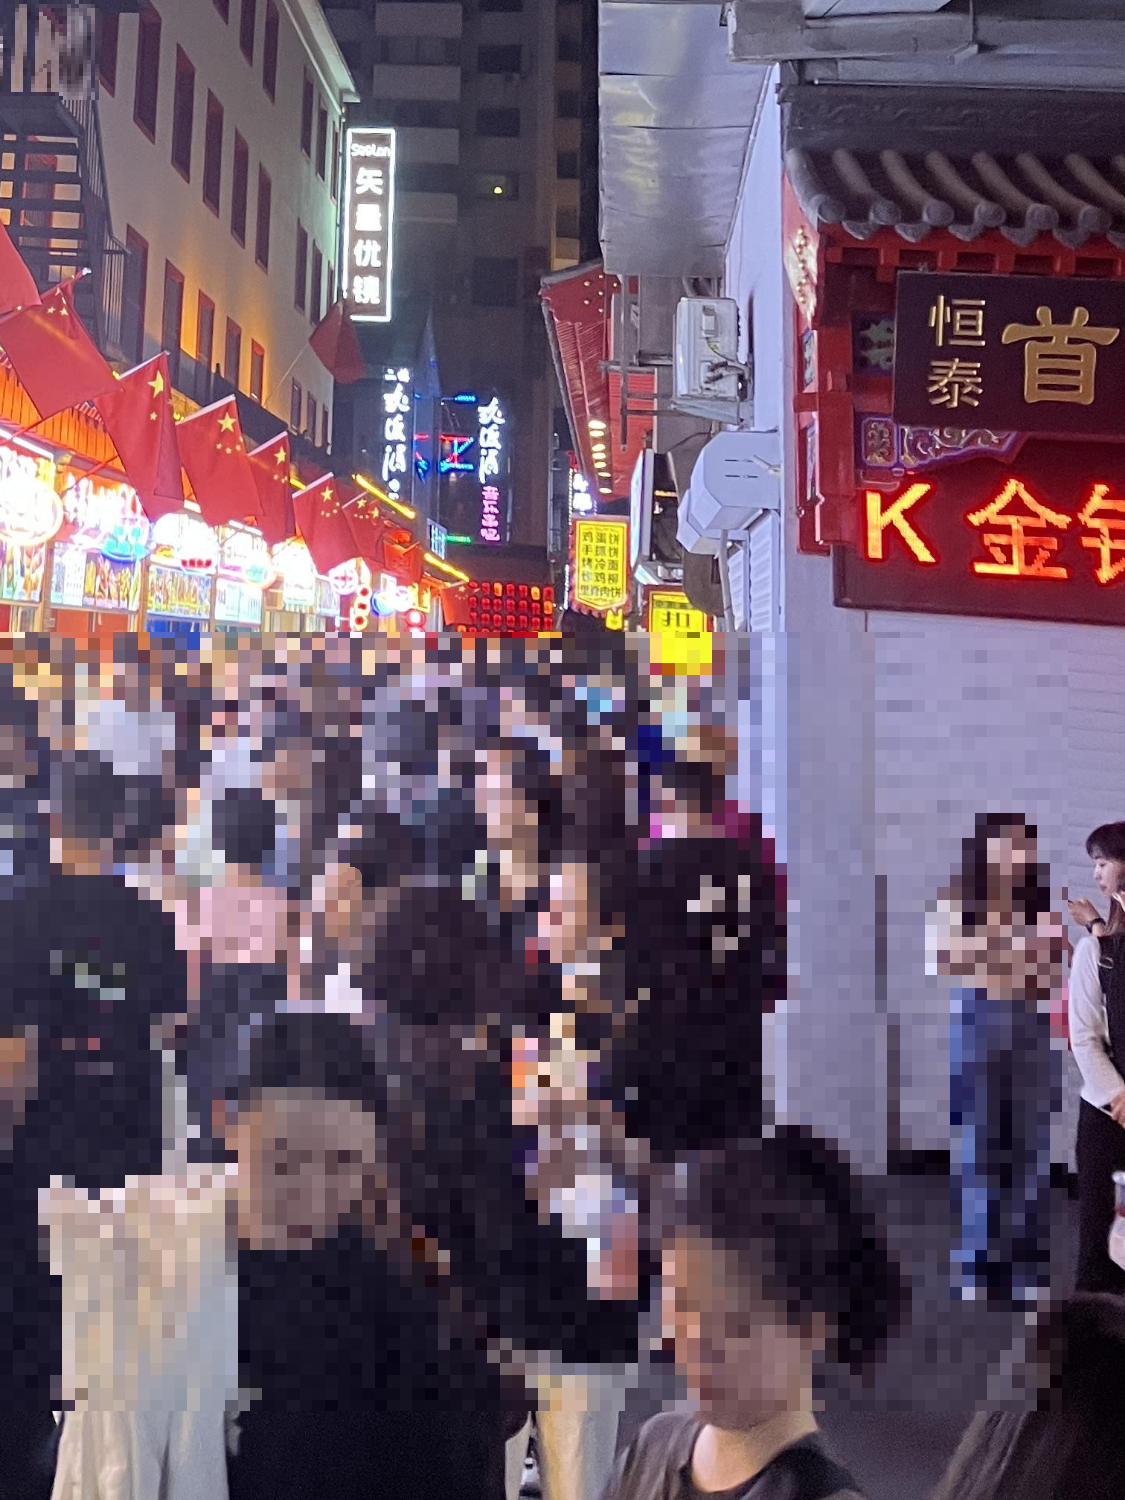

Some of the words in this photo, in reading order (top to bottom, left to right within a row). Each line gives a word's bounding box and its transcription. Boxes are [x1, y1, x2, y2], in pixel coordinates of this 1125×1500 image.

[353, 166, 384, 306] 矢量优镜
[928, 293, 986, 409] 恒泰
[1001, 305, 1121, 406] 首
